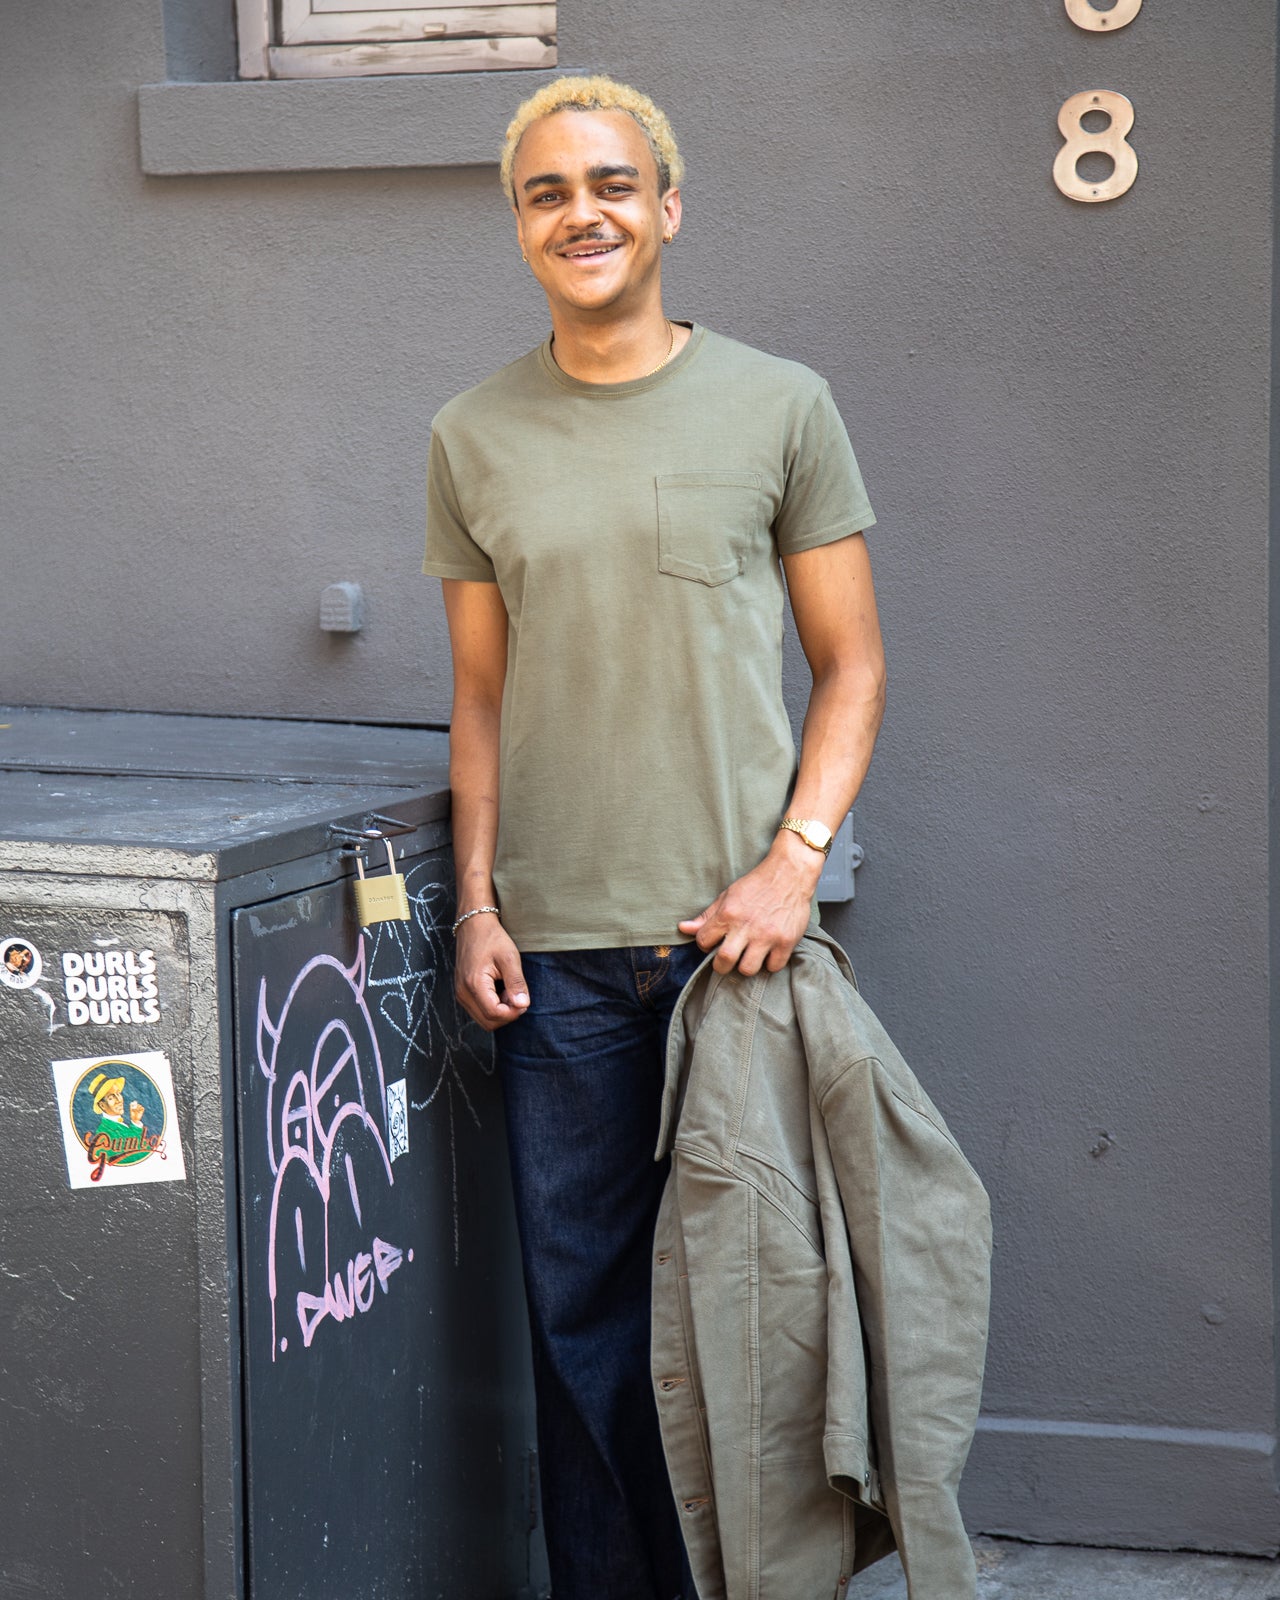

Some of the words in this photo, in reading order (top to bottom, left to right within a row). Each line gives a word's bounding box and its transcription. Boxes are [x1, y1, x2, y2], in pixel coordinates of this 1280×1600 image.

[1053, 89, 1138, 202] 8
[62, 950, 156, 976] DURLS
[65, 974, 158, 1000] DURLS
[68, 998, 160, 1025] DURLS
